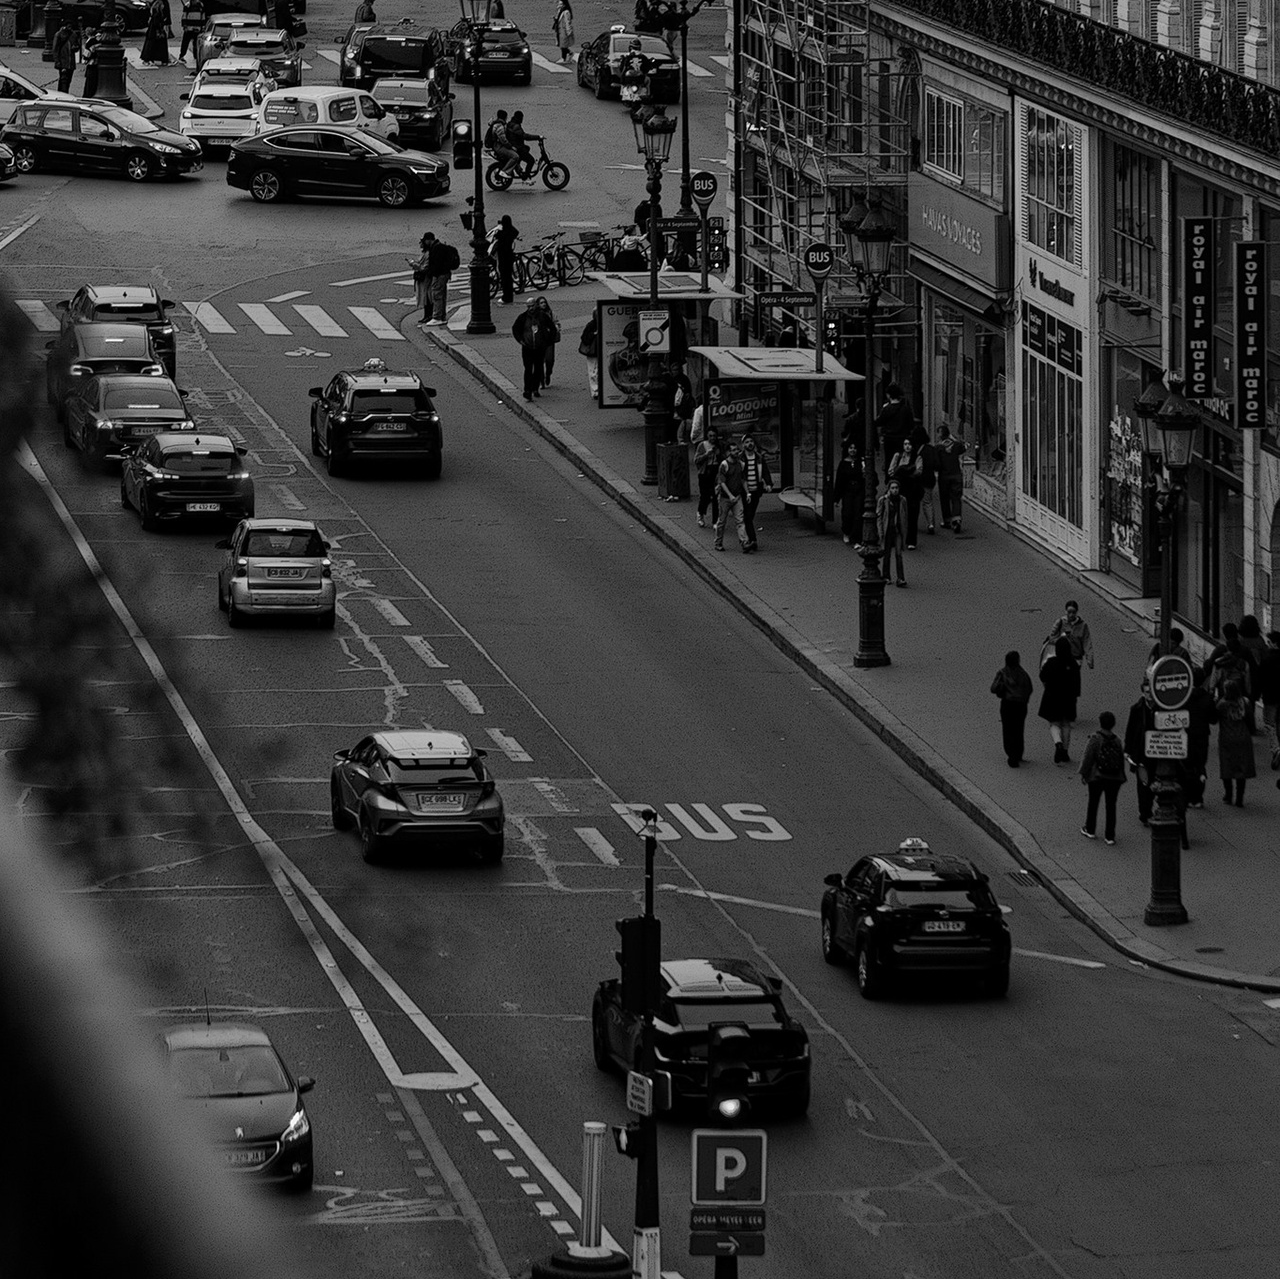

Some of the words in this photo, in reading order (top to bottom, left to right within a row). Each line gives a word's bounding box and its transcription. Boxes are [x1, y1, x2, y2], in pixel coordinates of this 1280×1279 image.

[694, 179, 714, 191] BUS
[808, 251, 830, 263] BUS
[1192, 225, 1206, 284] royal
[1245, 250, 1258, 311] royal
[760, 296, 777, 304] Opéra
[785, 296, 813, 305] Septembre
[1192, 296, 1206, 328] air
[826, 329, 838, 337] 95
[1244, 323, 1258, 356] air
[1190, 340, 1208, 393] maroc
[712, 397, 777, 417] LOOOOONG
[1242, 367, 1260, 423] maroc
[610, 802, 793, 841] BUS
[715, 1147, 747, 1192] P
[719, 1215, 763, 1225] MEYEREER
